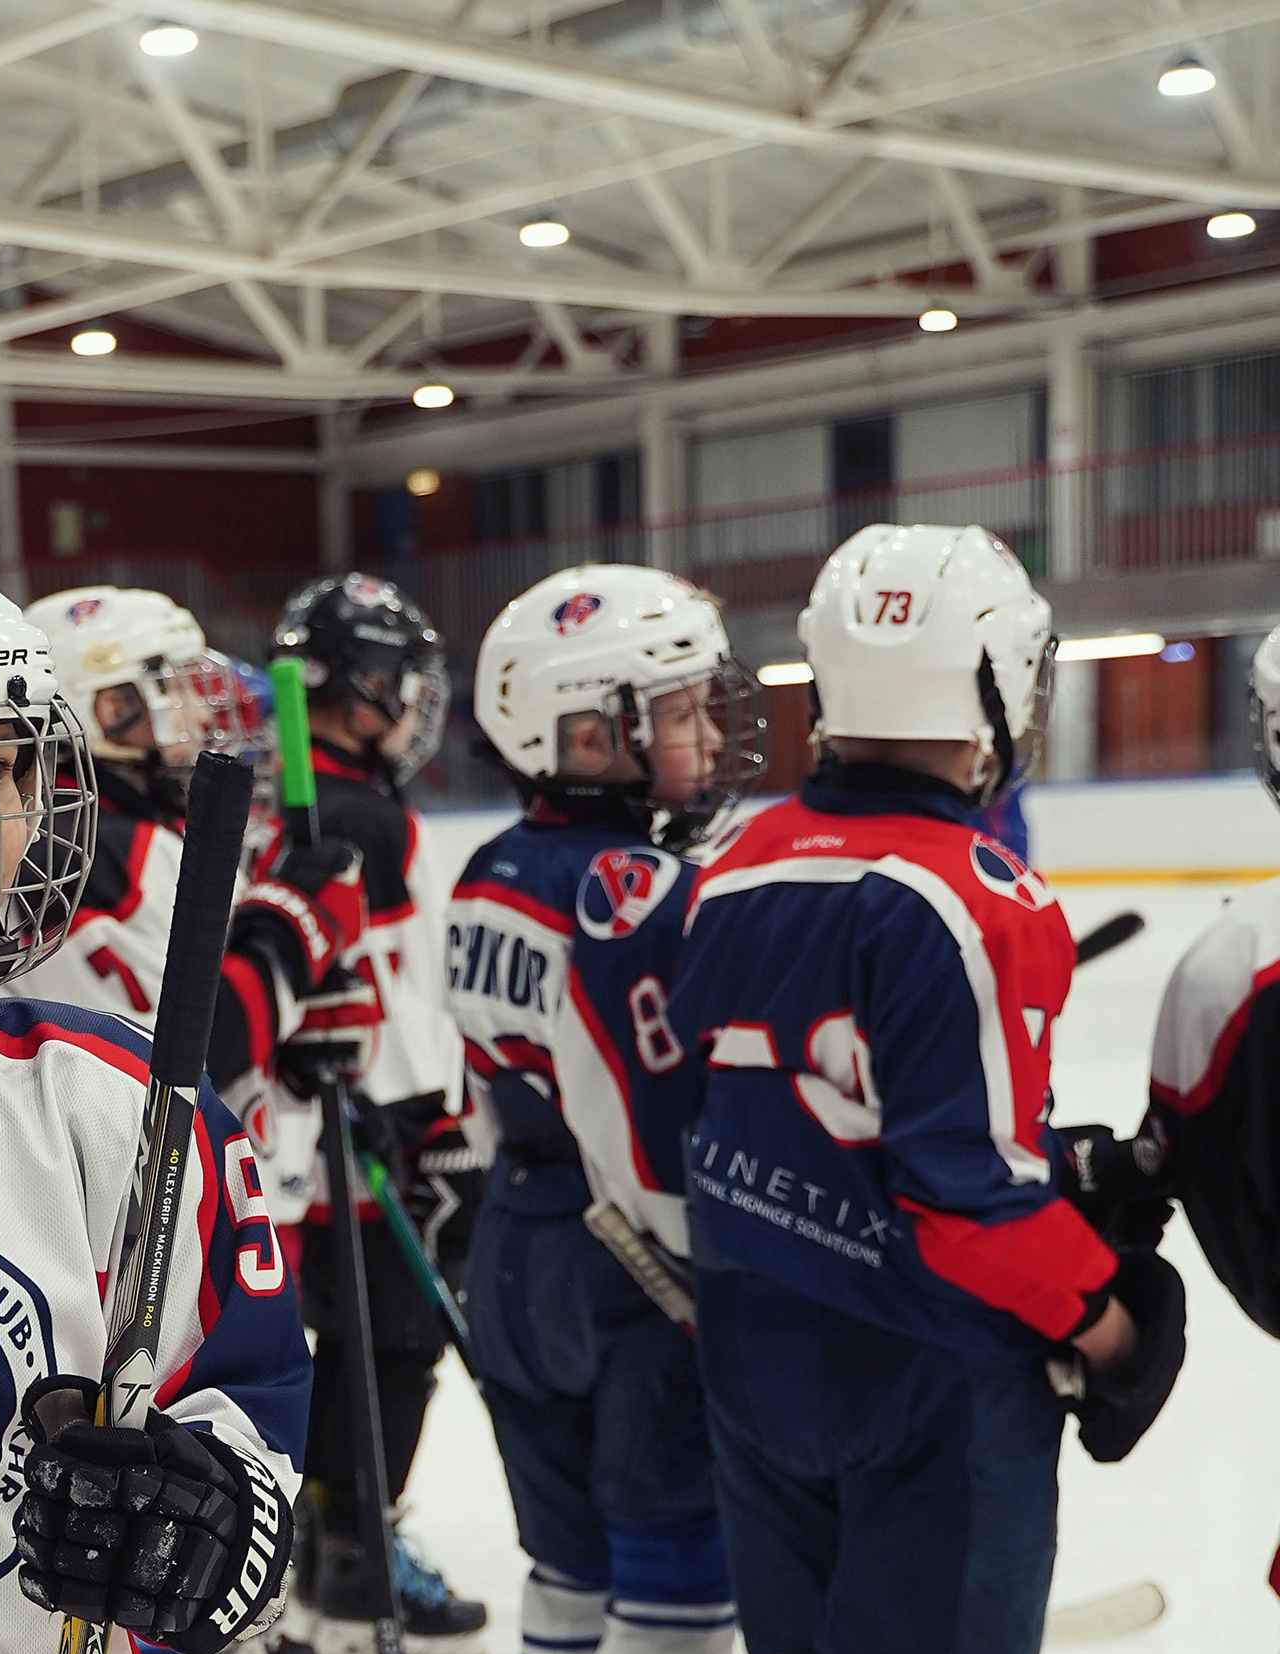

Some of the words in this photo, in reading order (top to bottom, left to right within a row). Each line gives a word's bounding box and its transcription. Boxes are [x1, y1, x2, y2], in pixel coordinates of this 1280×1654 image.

[875, 590, 912, 625] 73
[629, 974, 686, 1075] 8
[169, 1148, 180, 1164] 40
[164, 1164, 178, 1194] FLEX
[691, 1133, 889, 1246] INETIX
[161, 1197, 174, 1225] GRIP
[146, 1233, 168, 1302] MACKINNON
[142, 1304, 155, 1328] P40
[209, 1446, 279, 1635] RRIOR
